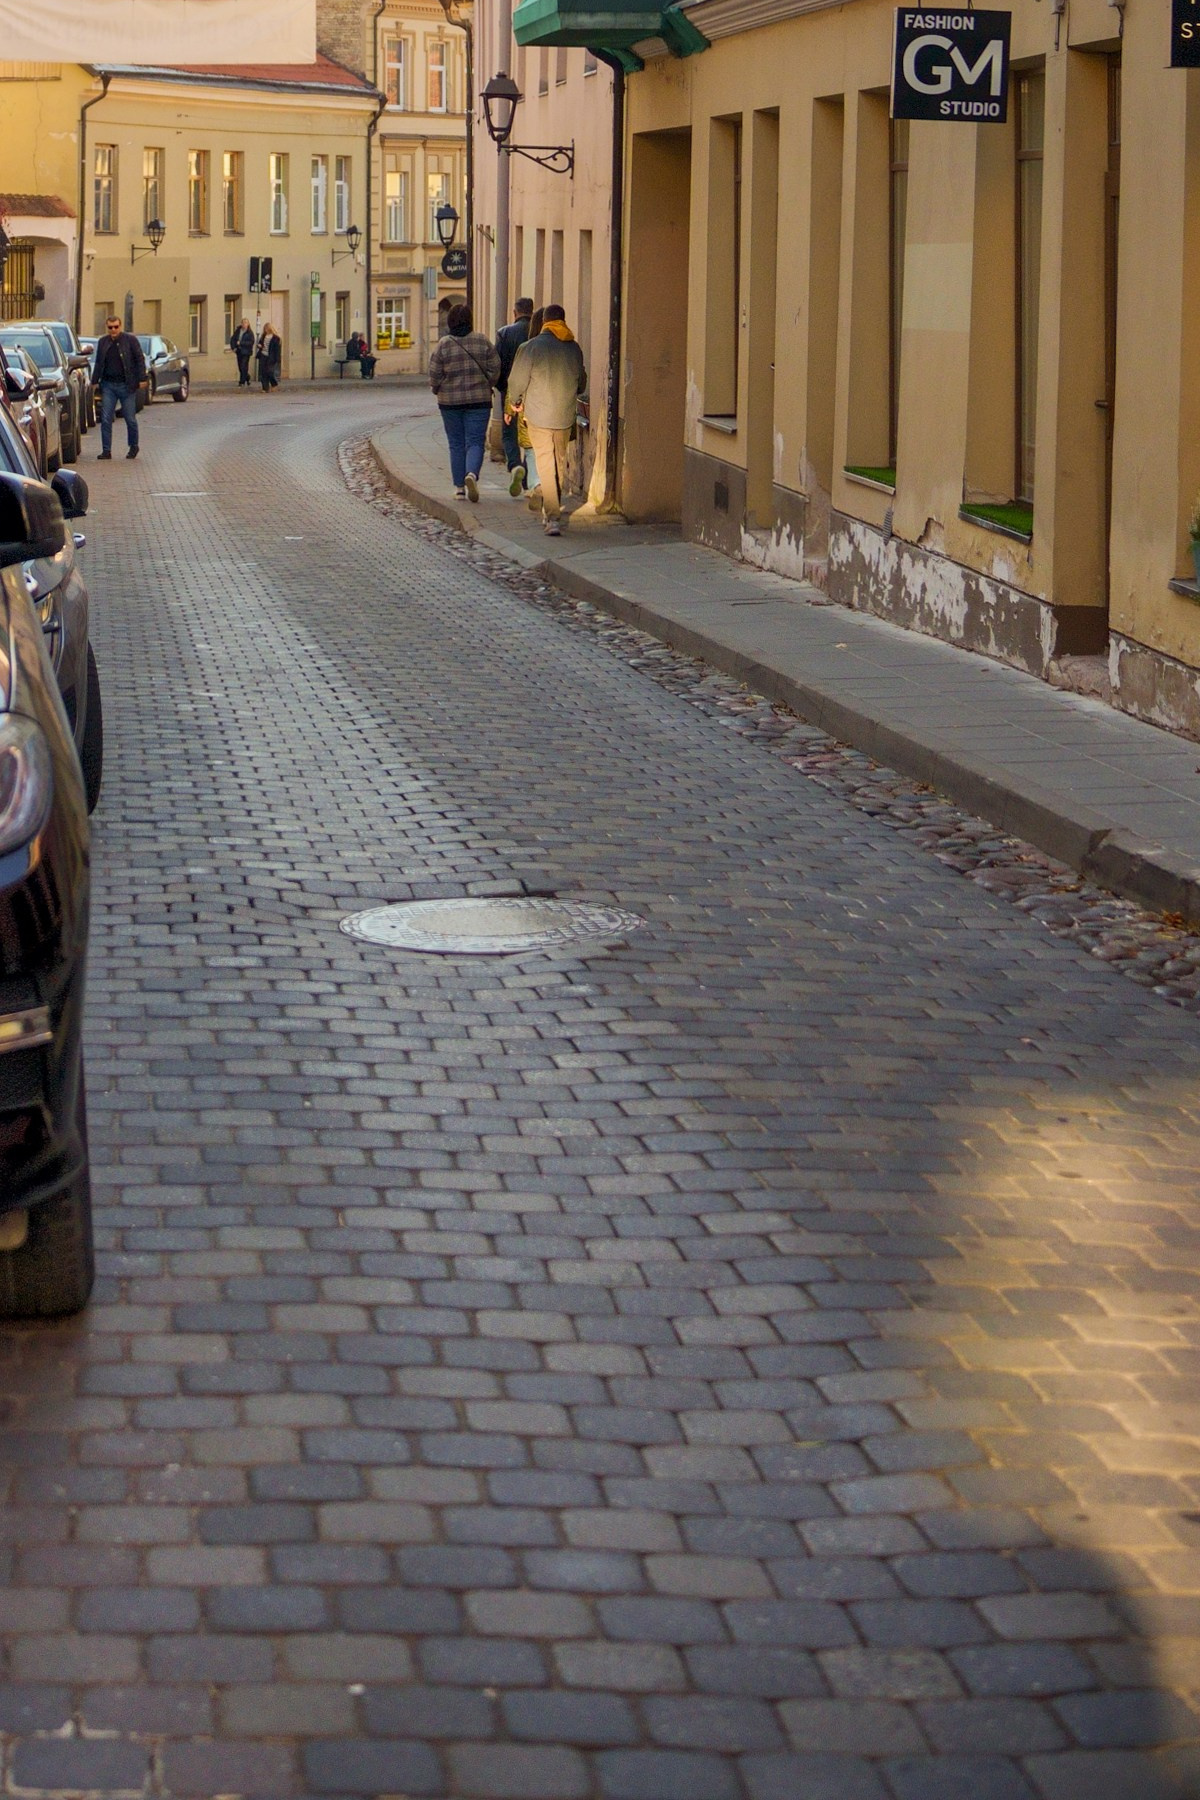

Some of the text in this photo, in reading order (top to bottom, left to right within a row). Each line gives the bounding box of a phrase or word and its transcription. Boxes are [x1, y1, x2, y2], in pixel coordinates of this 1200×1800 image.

[904, 14, 974, 31] FASHION
[902, 34, 1004, 96] GM
[940, 101, 1000, 117] STUDIO
